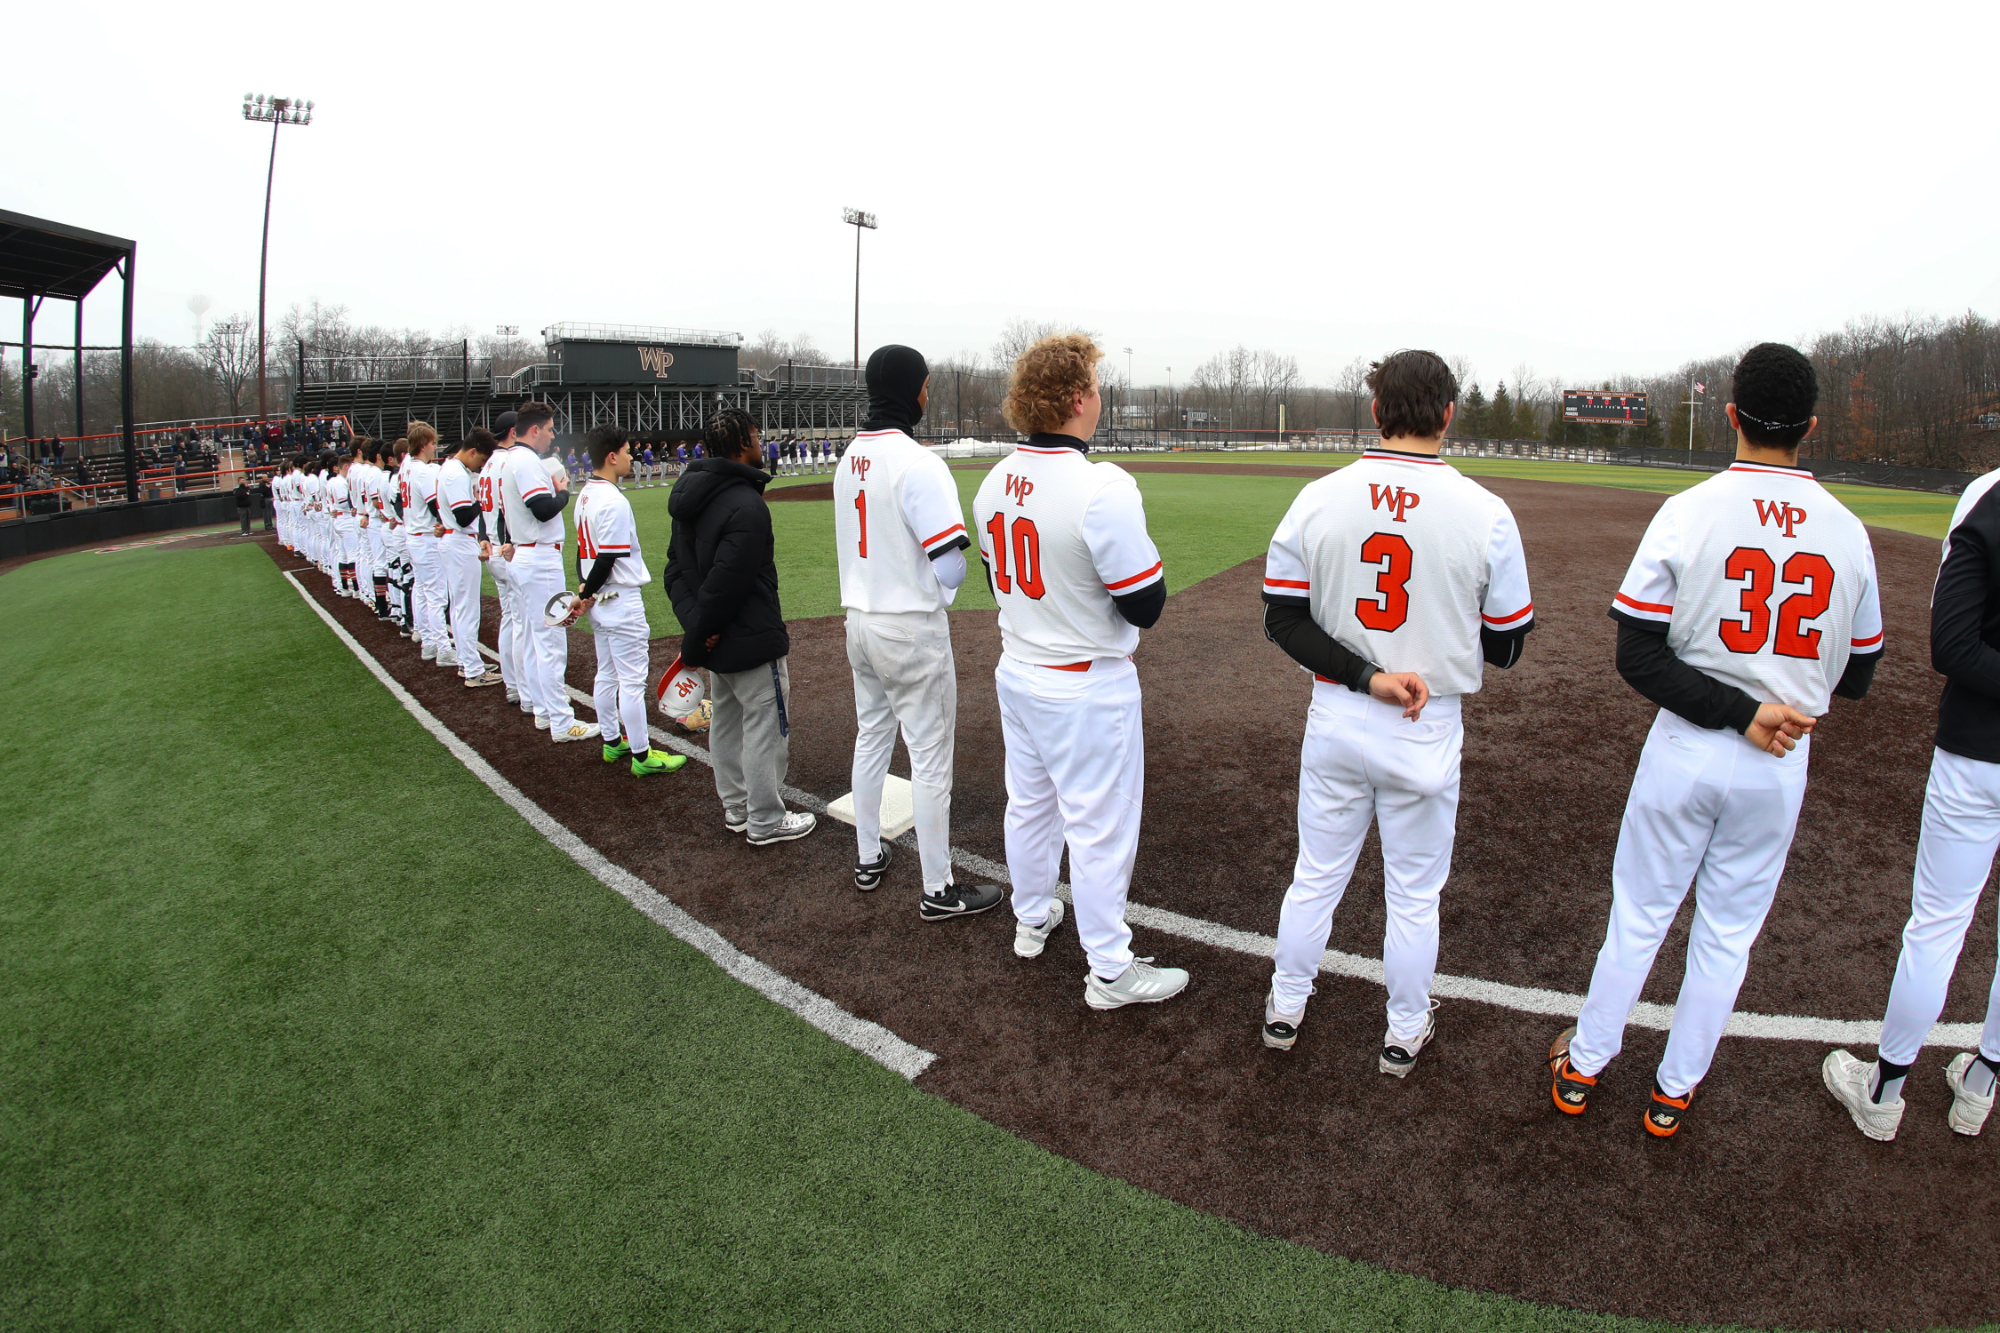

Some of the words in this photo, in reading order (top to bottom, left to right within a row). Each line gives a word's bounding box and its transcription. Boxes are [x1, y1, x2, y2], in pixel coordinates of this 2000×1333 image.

[637, 346, 674, 378] WP
[851, 456, 871, 481] WP
[1005, 473, 1034, 507] WP
[1368, 483, 1420, 523] WP
[855, 489, 868, 559] 1
[1752, 498, 1807, 539] WP
[987, 511, 1046, 601] 10
[1355, 531, 1413, 633] 3
[1718, 546, 1835, 660] 32
[675, 677, 698, 698] WP
